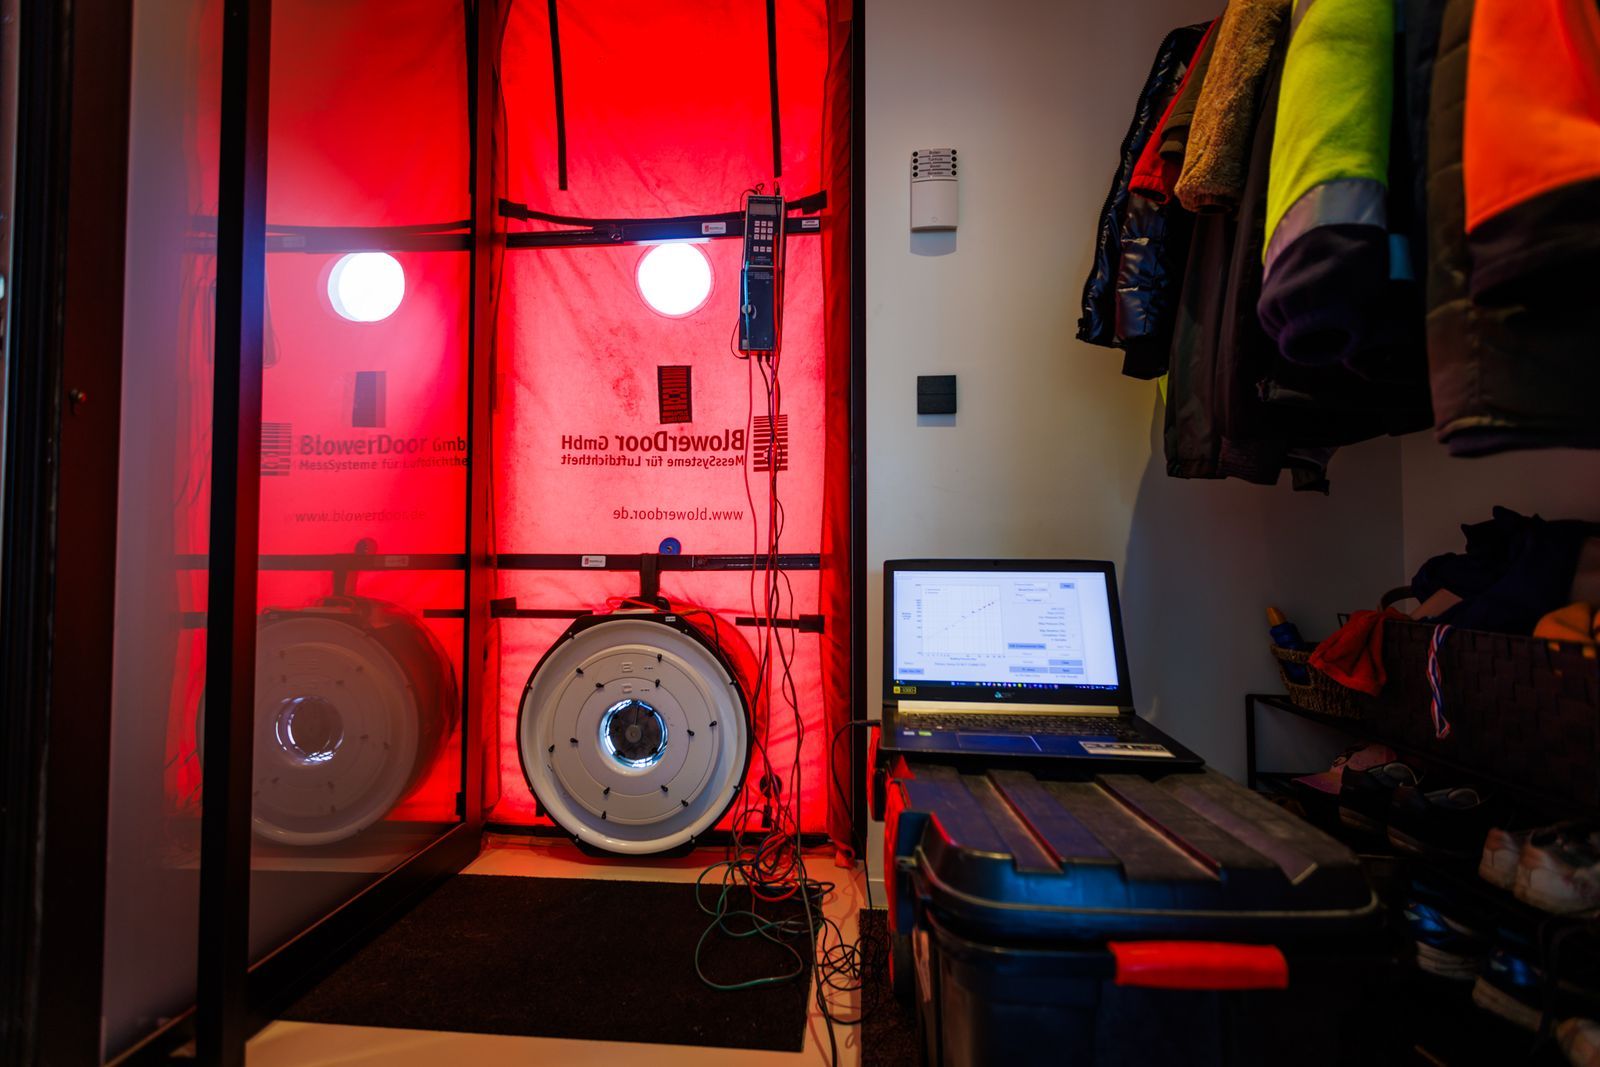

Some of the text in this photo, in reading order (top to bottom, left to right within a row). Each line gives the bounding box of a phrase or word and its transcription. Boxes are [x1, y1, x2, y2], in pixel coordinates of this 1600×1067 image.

[299, 434, 467, 456] BlowerDoor Gmb
[299, 458, 377, 473] MessSysteme
[402, 456, 469, 469] Luftdichthe
